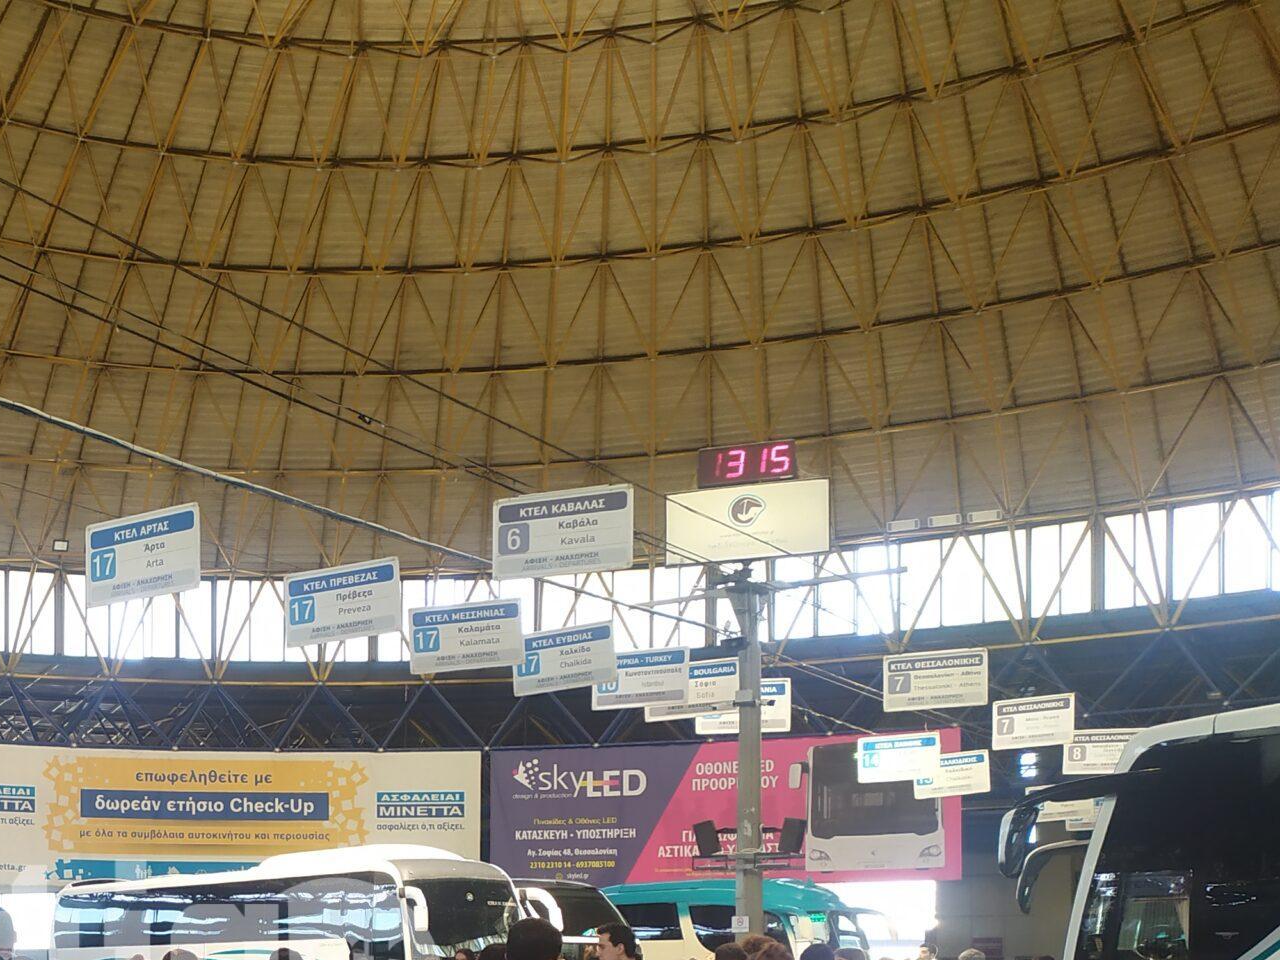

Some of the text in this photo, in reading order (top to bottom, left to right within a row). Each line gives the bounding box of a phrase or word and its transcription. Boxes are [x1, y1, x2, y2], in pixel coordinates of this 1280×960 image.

[520, 498, 606, 518] ΚΤΕΛ ΚΑΒΑΛΑΣ
[558, 517, 598, 530] Καβάλα
[114, 521, 169, 542] ΚΤΕΛ ΑΡΤΑΣ
[507, 528, 521, 550] 6
[560, 533, 595, 546] Kavala
[92, 553, 114, 578] 17
[146, 558, 164, 568] Arta
[303, 571, 378, 592] ΚΤΕΛ ΠΡΕΒΕΖΑΣ
[335, 589, 373, 602] Πρέβεζα
[291, 599, 313, 622] 17
[338, 604, 371, 616] Preveza
[425, 608, 506, 623] ΚΤΕΛ ΜΕΣΣΗΝΙΑΣ
[416, 630, 438, 650] 17
[532, 632, 593, 649] ΚΤΕΛ ΕΥΒΟΙΑΣ
[645, 655, 672, 664] TURKEY
[890, 656, 980, 671] ΚΤΕΛ ΘΕΣΣΑΛΟΝΙΚΗΣ
[694, 666, 735, 676] BOULGARIA
[894, 676, 904, 692] 7
[1001, 719, 1010, 733] 7
[1072, 748, 1081, 760] 8
[696, 761, 739, 775] ΟΘΟΝΕ
[136, 770, 273, 786] επωφεληθείτε με
[381, 793, 460, 802] ΑΣΦΑΛΕΙΑΙ
[95, 794, 314, 816] δωρεάν ετήσιο Check-Up
[380, 806, 462, 816] MINETTA
[376, 822, 419, 832] ασφαλίζει
[515, 828, 636, 840] ΚΑΤΑΣΚΕΥΗ ΥΠΟΣΤΗΡΙΞΗ
[80, 828, 330, 841] με όλα τα συμβόλαια αυτοκινήτου και περιουσίας
